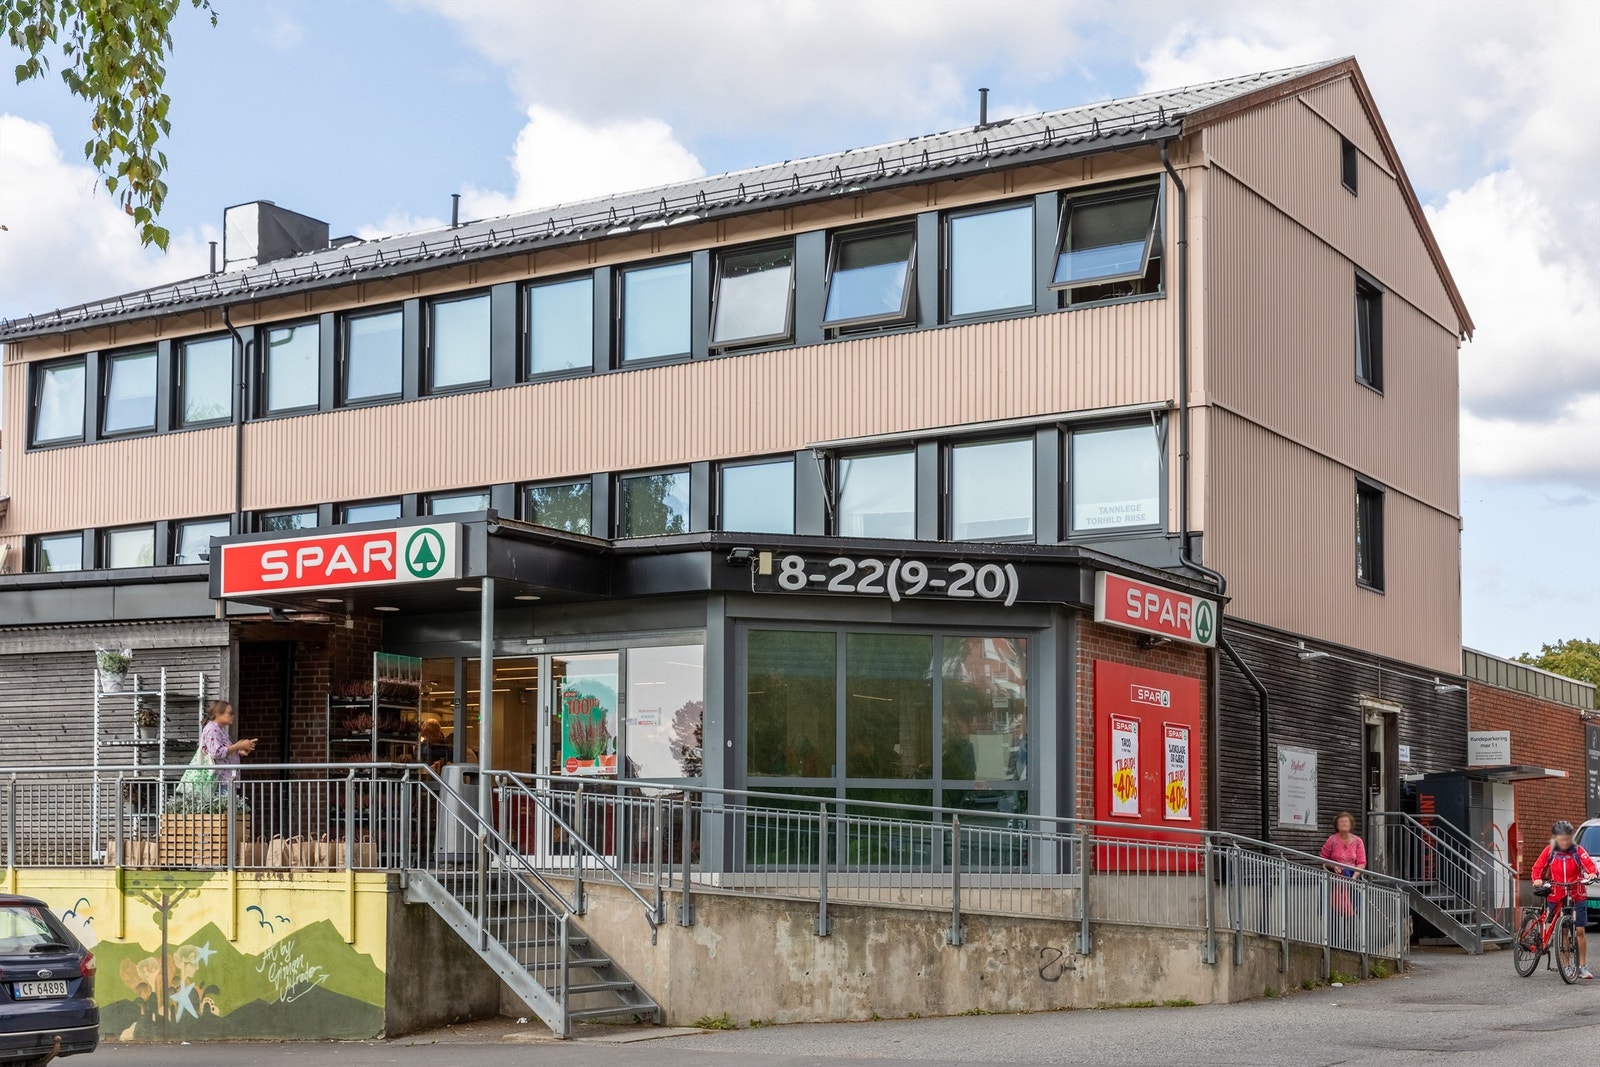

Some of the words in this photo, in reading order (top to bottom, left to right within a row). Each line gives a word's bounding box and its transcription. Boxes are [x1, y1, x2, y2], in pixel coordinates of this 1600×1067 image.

[1086, 515, 1122, 525] TORHILD
[1124, 513, 1147, 523] RIISE
[1098, 504, 1142, 515] TANNLEGE
[260, 540, 393, 582] SPAR
[778, 555, 1019, 607] 8-22(9-20)
[1126, 588, 1191, 631] SPAR
[1137, 688, 1161, 703] SPAR
[1116, 722, 1132, 731] SPAR
[1168, 730, 1183, 738] SPAR
[1113, 773, 1137, 800] -40%
[1165, 786, 1188, 810] -40%
[280, 940, 295, 963] by
[22, 983, 34, 996] CF
[37, 981, 66, 995] 64898
